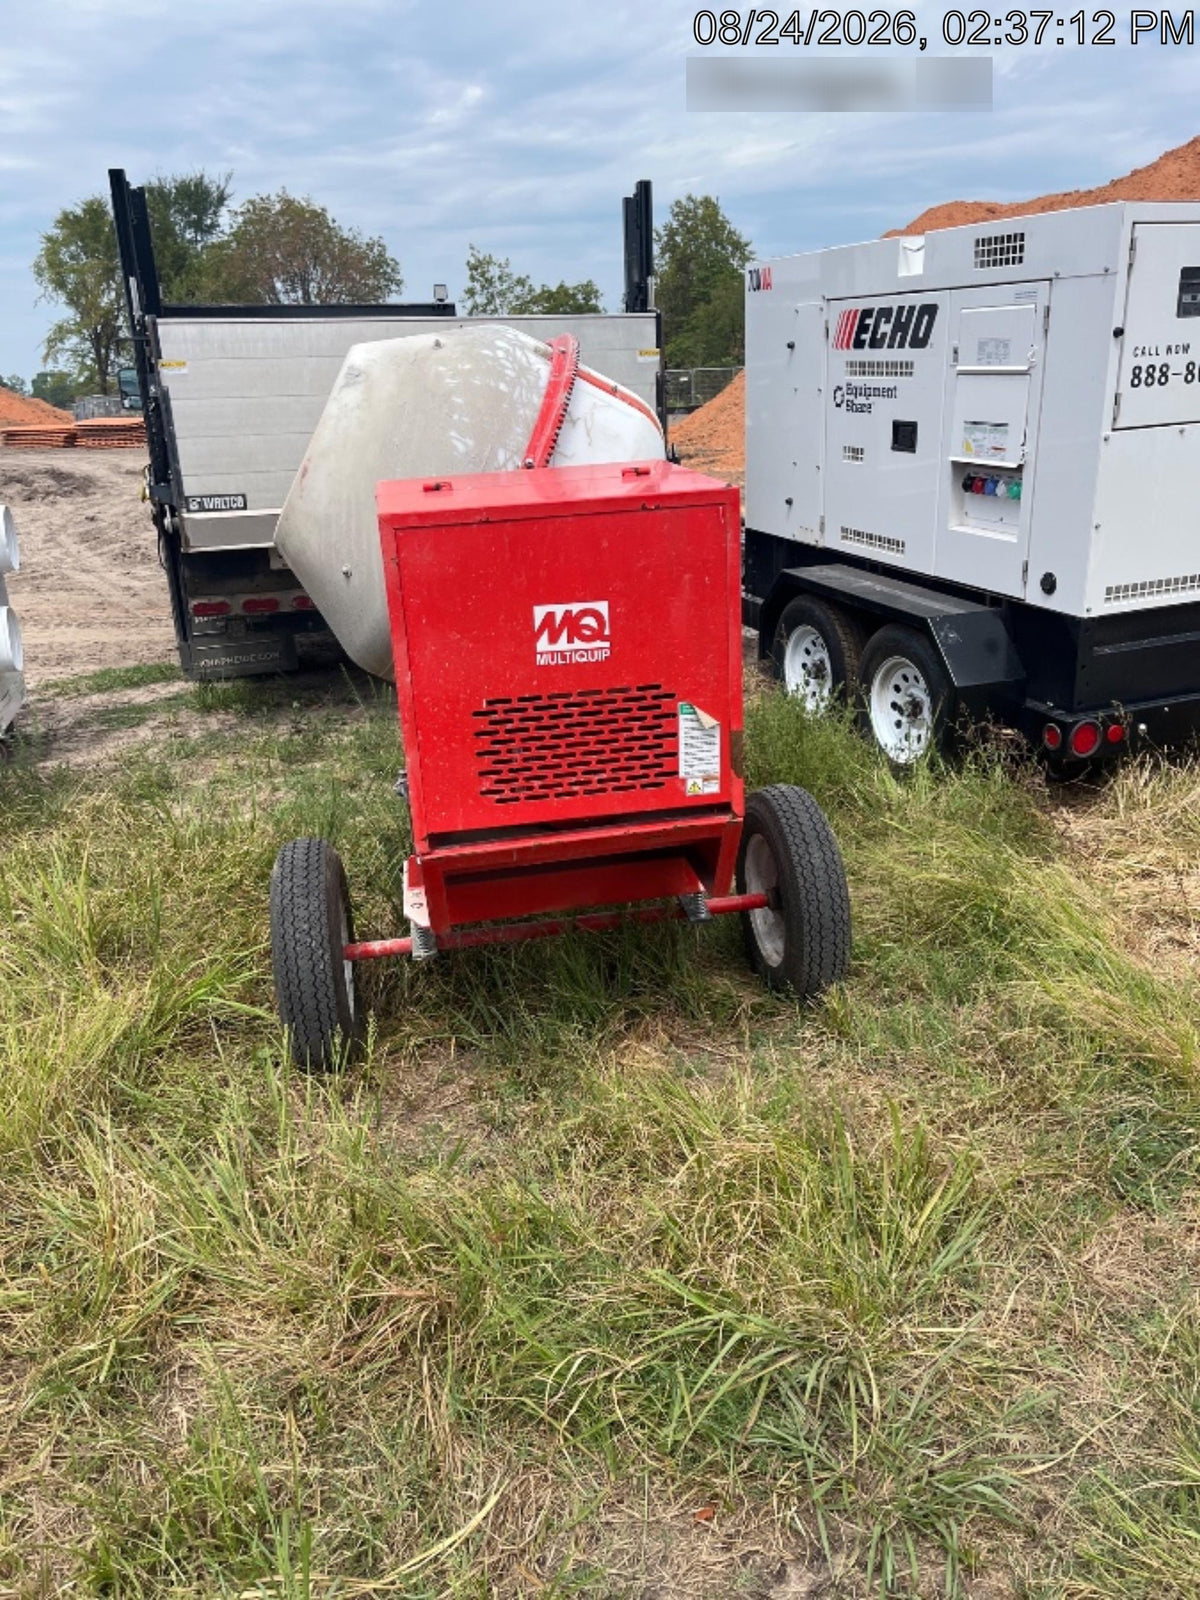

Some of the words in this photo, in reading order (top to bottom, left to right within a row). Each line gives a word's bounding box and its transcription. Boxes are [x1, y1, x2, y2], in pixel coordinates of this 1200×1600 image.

[852, 303, 939, 350] ECHO
[1132, 346, 1160, 358] CALL
[1166, 342, 1191, 356] NOW
[1130, 360, 1200, 388] 888-8
[846, 382, 898, 400] Equipment
[846, 399, 872, 414] Share
[533, 605, 611, 647] MQ
[536, 648, 611, 666] MULTIQUIP
